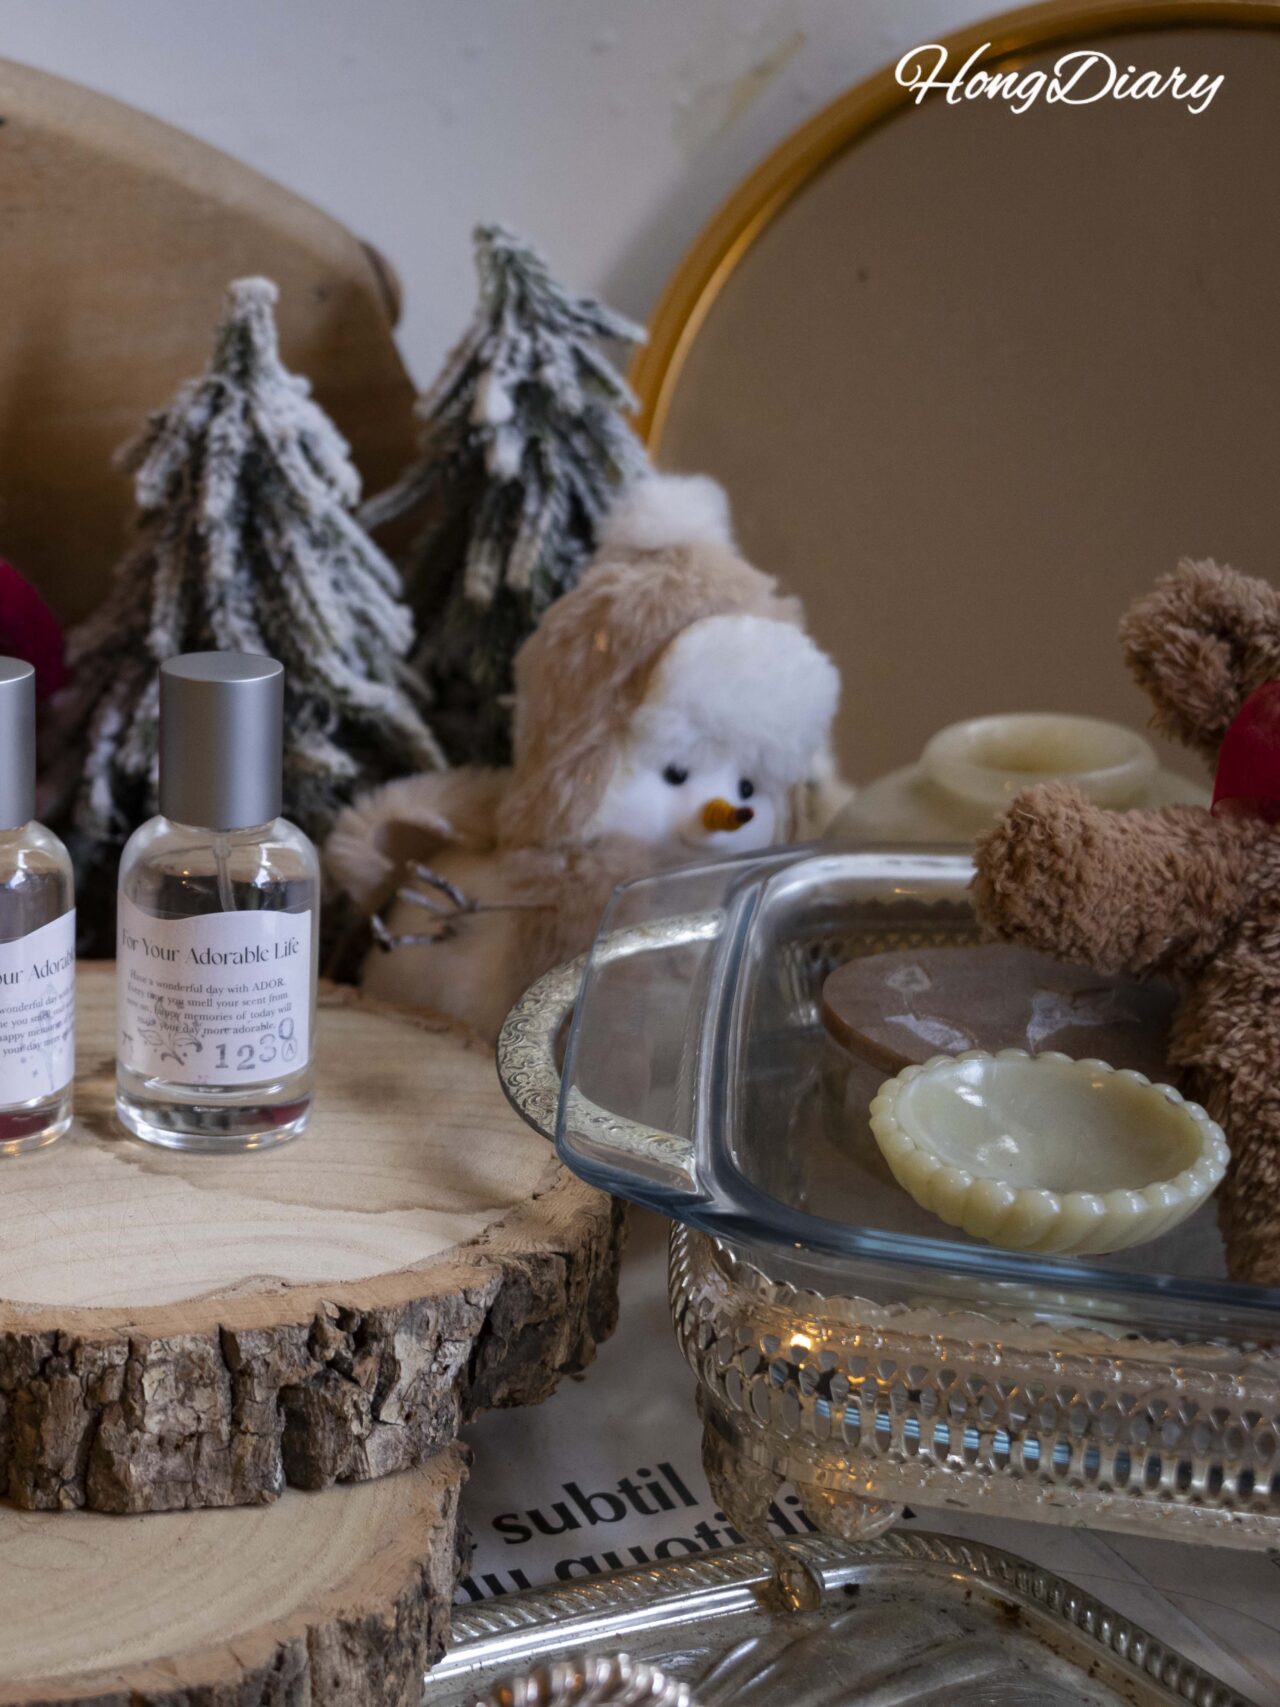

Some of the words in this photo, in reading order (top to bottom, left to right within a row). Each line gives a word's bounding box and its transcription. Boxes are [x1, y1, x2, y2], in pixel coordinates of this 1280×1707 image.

[122, 927, 139, 951] For
[142, 937, 180, 962] Your
[185, 944, 270, 966] Adorable
[275, 937, 300, 960] Life
[156, 981, 203, 994] wonderful
[205, 984, 224, 997] day
[227, 983, 249, 994] with
[187, 998, 213, 1008] smell
[216, 999, 238, 1009] your
[242, 995, 266, 1006] scent
[268, 991, 289, 1005] from
[184, 1010, 233, 1021] memories
[236, 1011, 246, 1021] of
[250, 1007, 276, 1019] today
[278, 1001, 292, 1014] will
[11, 1017, 28, 1029] you
[182, 1022, 200, 1034] day
[203, 1026, 230, 1035] more
[2, 1045, 24, 1057] your
[491, 1461, 700, 1545] subtil
